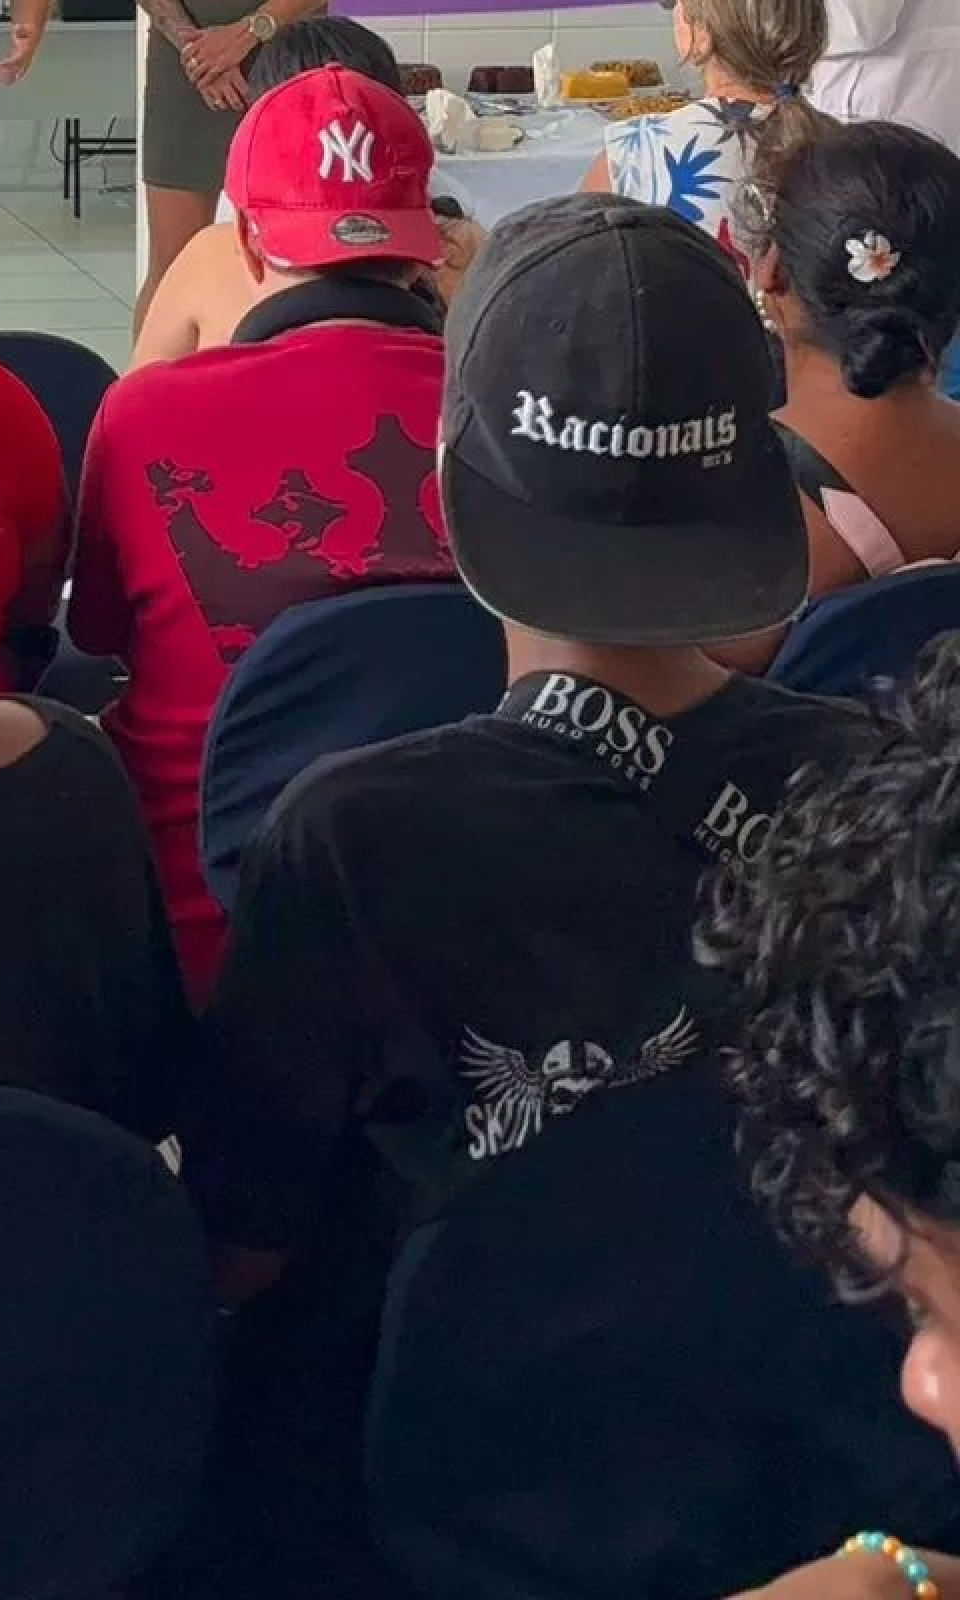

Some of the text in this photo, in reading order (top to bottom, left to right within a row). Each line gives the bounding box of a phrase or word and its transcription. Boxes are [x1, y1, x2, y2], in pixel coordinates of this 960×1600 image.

[318, 119, 375, 183] NY
[510, 389, 738, 458] Racionais
[521, 711, 583, 741] HUGO
[531, 673, 674, 775] BOSS
